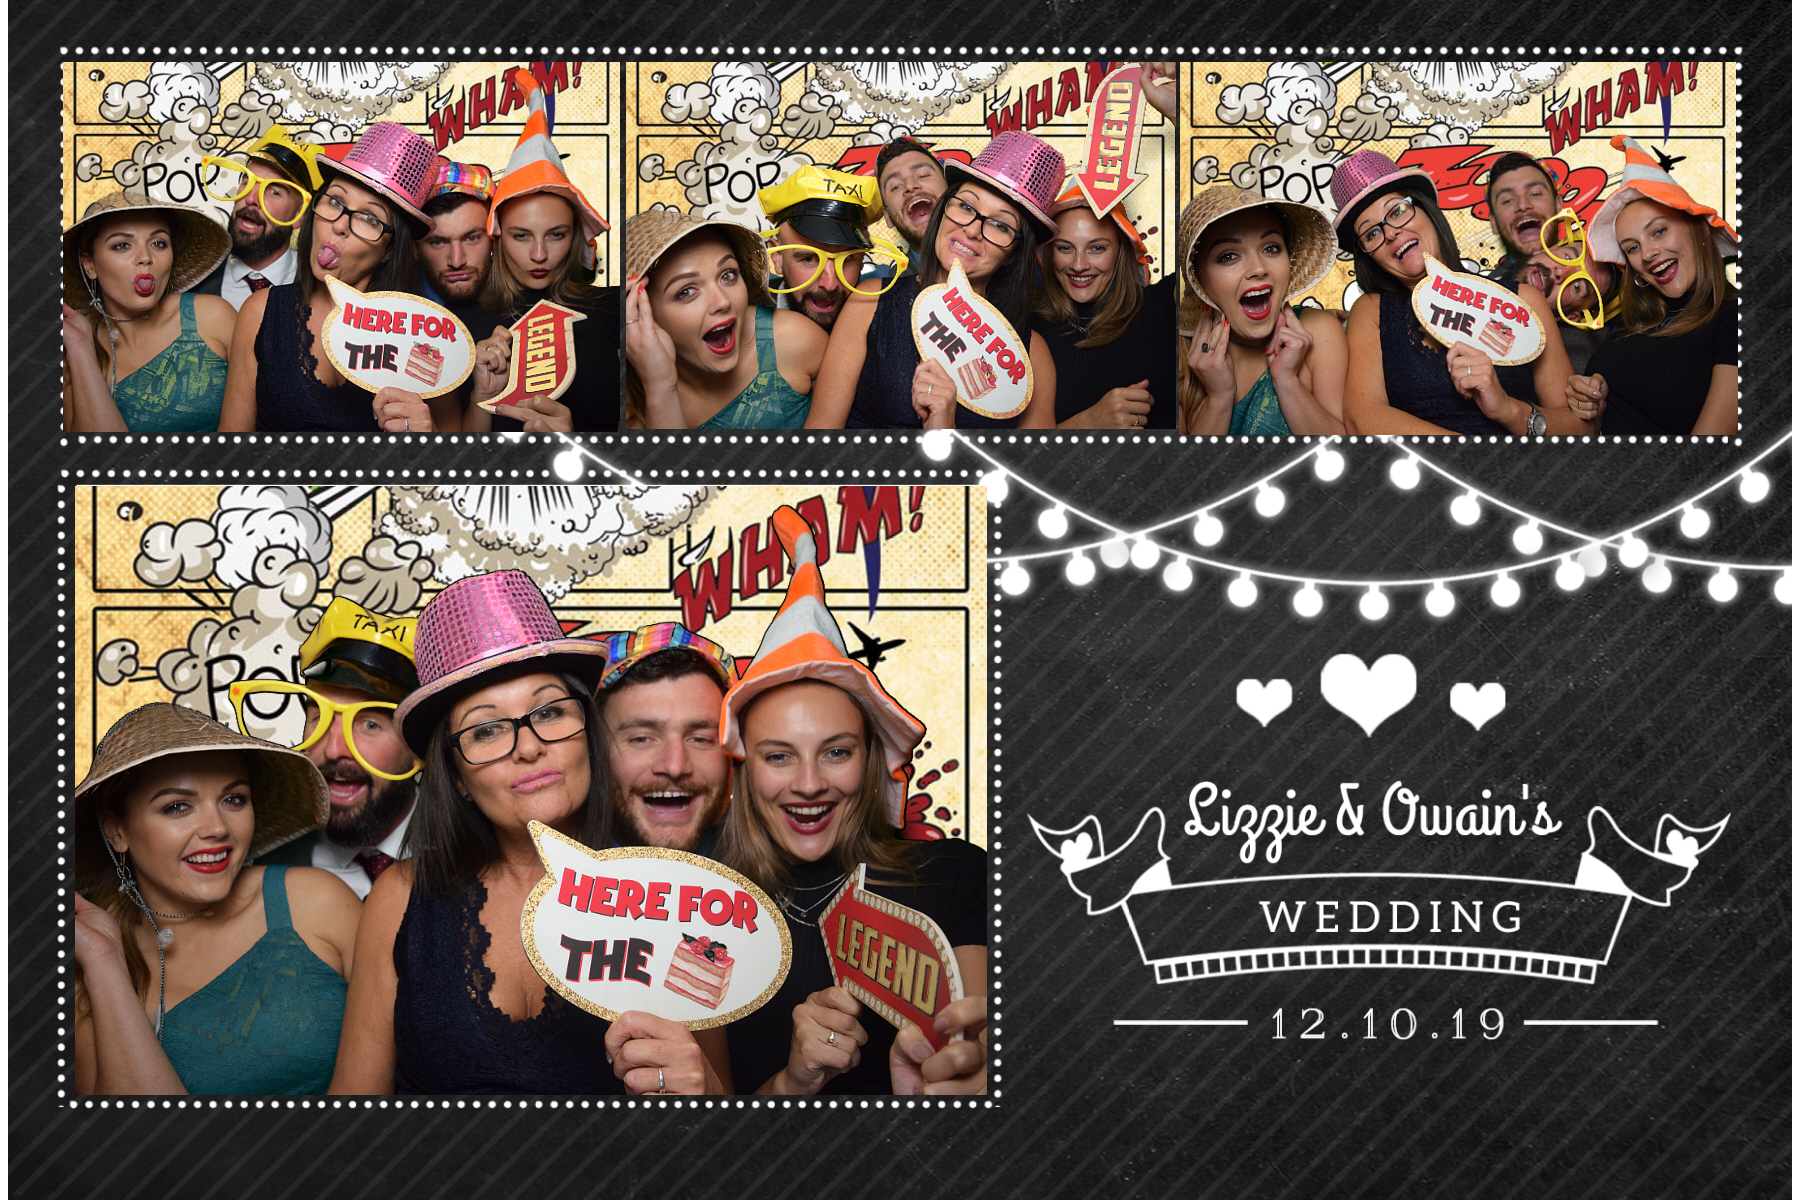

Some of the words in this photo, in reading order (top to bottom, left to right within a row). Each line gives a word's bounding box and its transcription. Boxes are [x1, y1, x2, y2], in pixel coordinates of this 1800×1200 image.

[1093, 80, 1135, 191] LEGEND
[1545, 62, 1698, 156] WHAM!
[143, 163, 220, 203] POP
[704, 161, 781, 204] POP
[823, 178, 863, 199] TAXI
[1259, 163, 1337, 204] POP
[342, 302, 407, 335] HERE
[411, 313, 457, 343] FOR
[1430, 302, 1476, 338] THE
[1431, 274, 1488, 310] HERE
[1489, 296, 1530, 327] FOR
[344, 341, 399, 373] THE
[525, 313, 558, 394] LEGEND
[920, 310, 968, 364] THE
[942, 286, 995, 345] HERE
[985, 336, 1026, 385] FOR
[353, 614, 407, 642] TAXI
[557, 867, 672, 921] HERE
[677, 885, 759, 934] FOR
[560, 933, 655, 988] THE
[835, 911, 941, 1017] LEGEND
